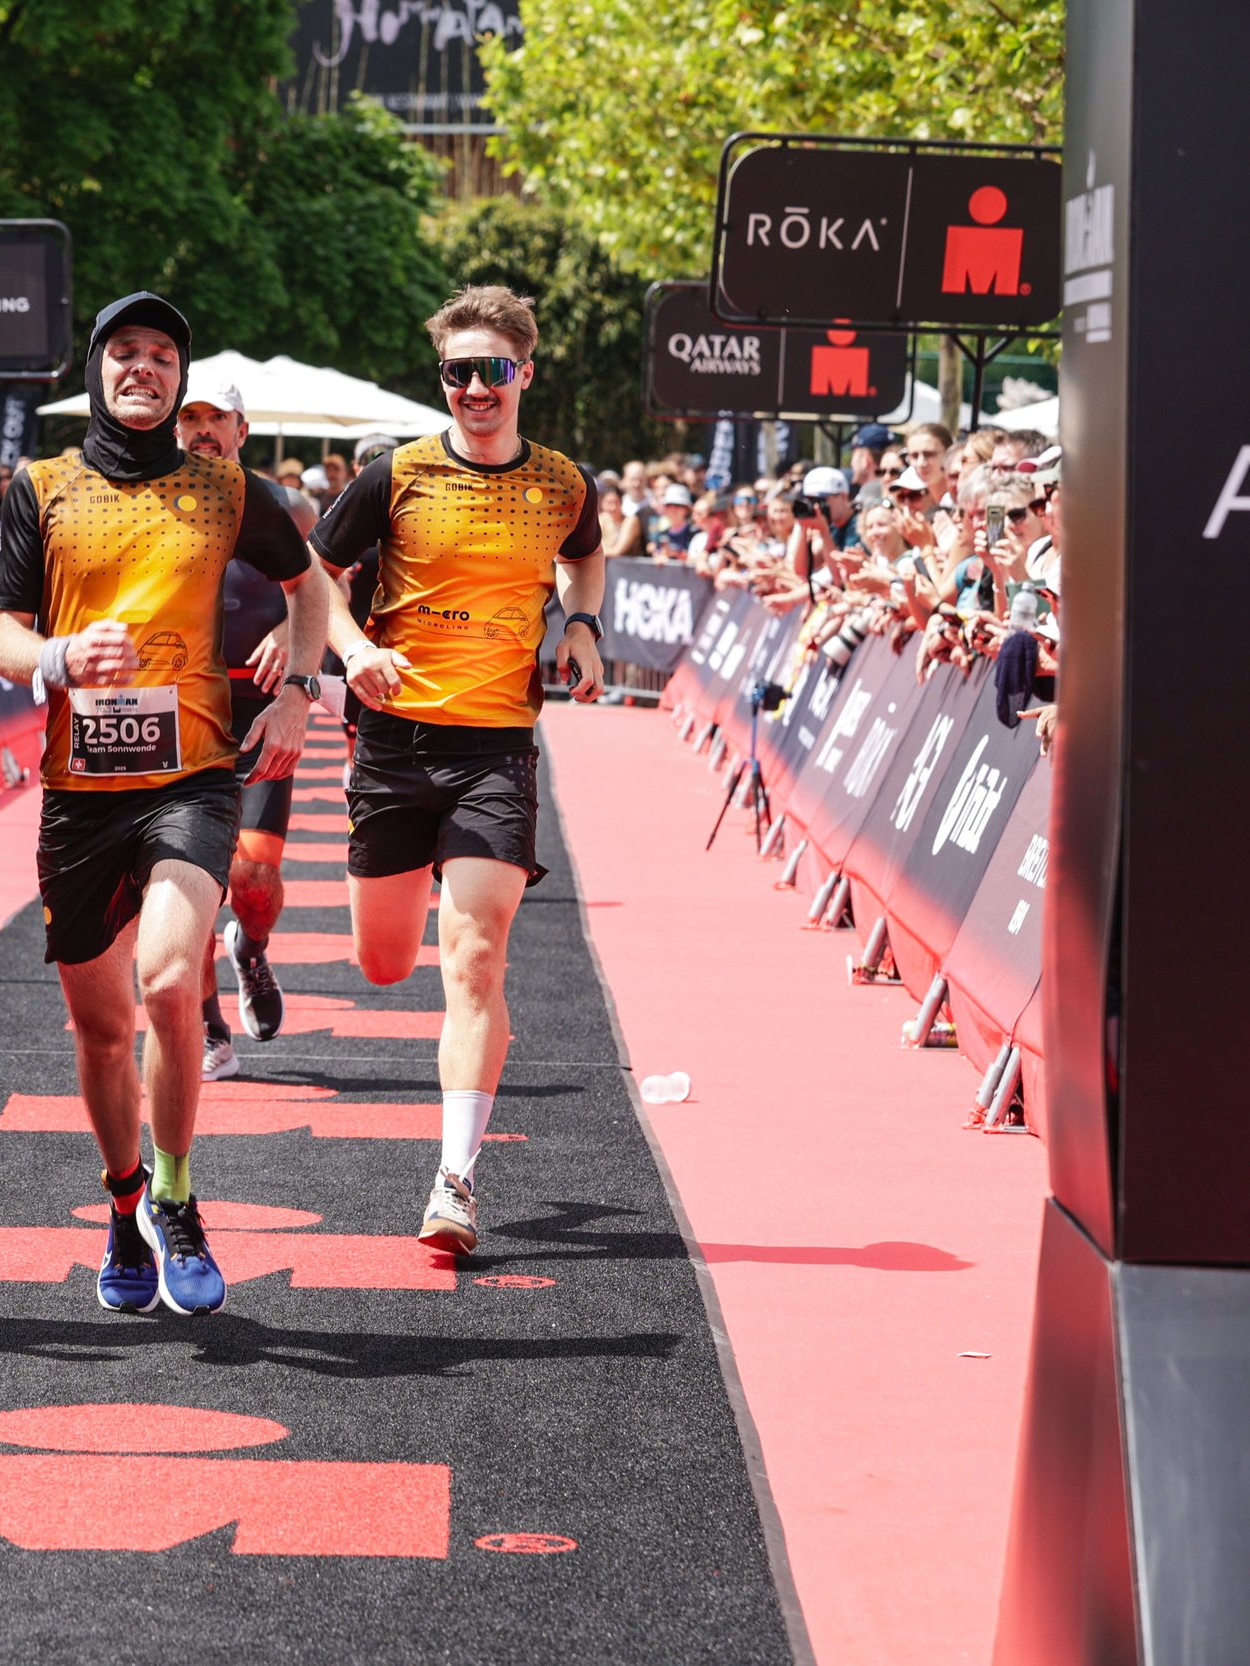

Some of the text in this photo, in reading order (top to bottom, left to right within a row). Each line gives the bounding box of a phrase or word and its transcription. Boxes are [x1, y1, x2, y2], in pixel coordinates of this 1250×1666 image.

[668, 333, 760, 363] QATAR
[690, 359, 761, 376] AIRWAYS
[445, 482, 474, 491] GOBIK
[90, 494, 120, 504] GOBIK
[613, 577, 694, 645] HOKA
[95, 694, 138, 706] IRONMAN
[82, 717, 161, 744] 2506
[86, 744, 157, 753] Team Sonnwende
